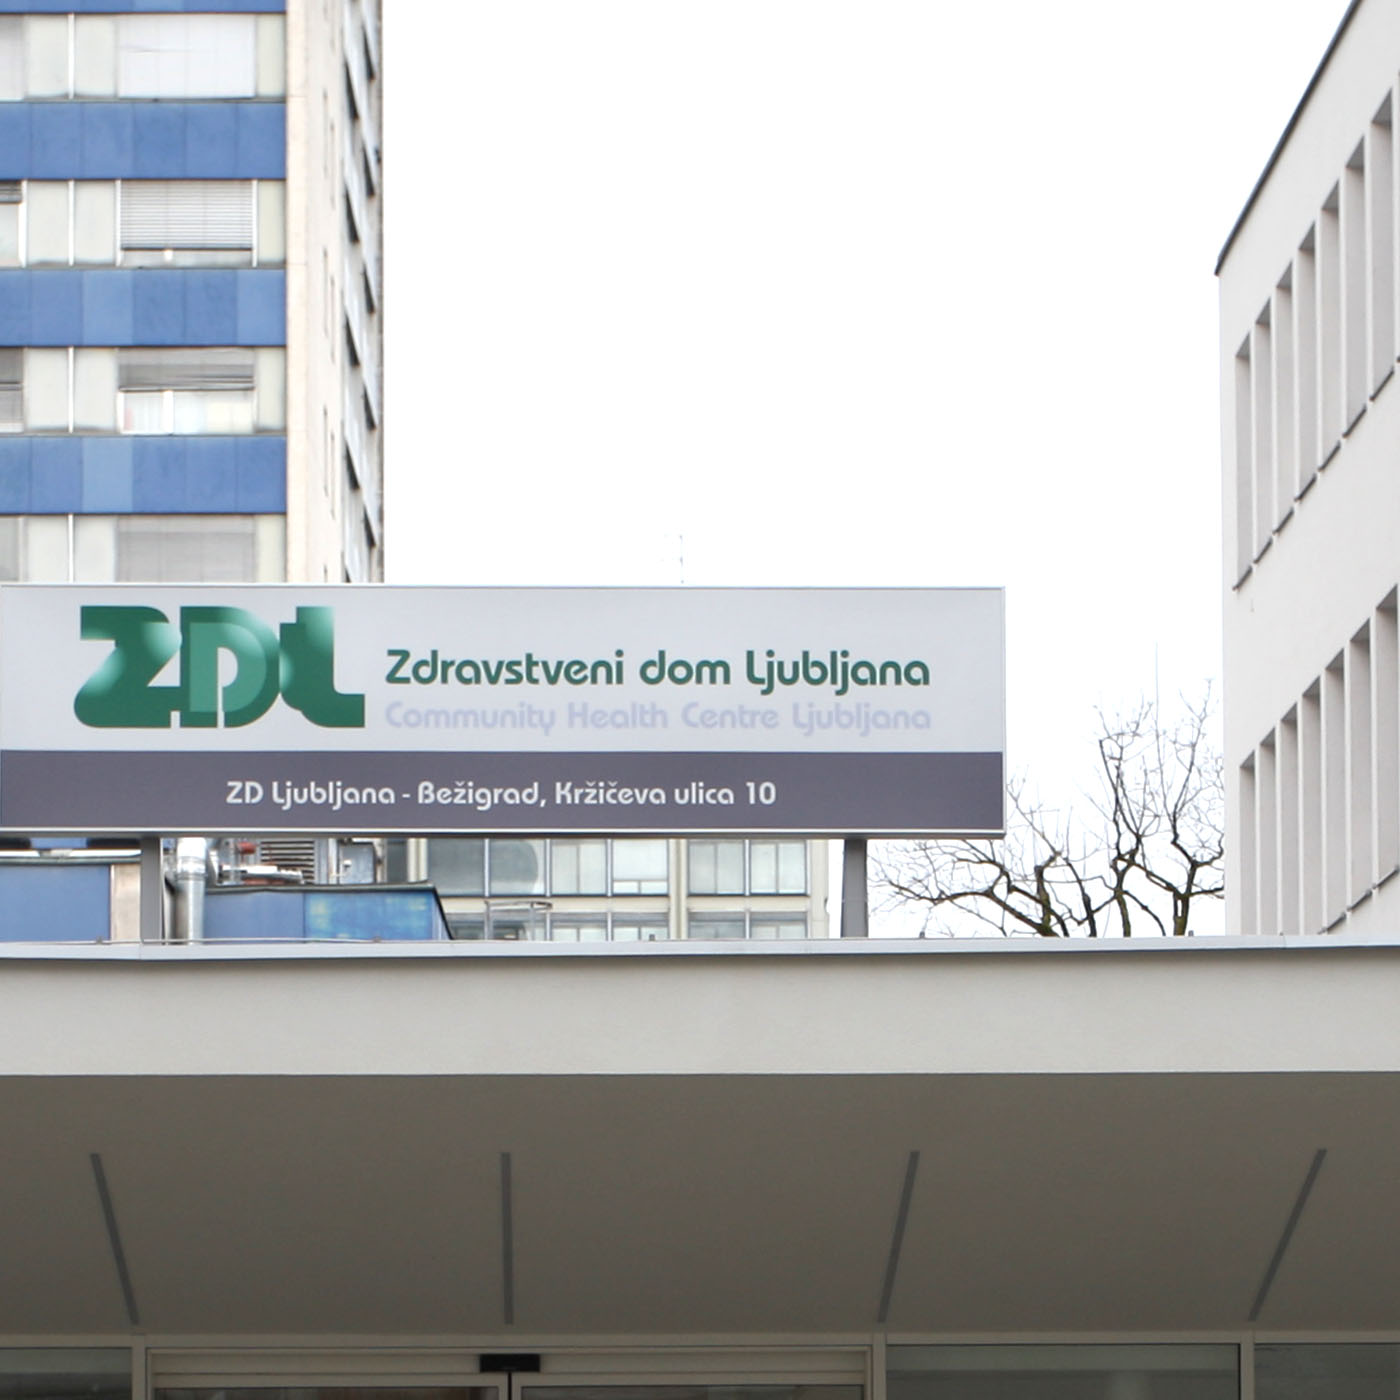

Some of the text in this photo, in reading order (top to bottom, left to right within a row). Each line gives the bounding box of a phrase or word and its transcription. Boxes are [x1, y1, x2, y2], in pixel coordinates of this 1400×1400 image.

[73, 606, 365, 729] ZDL
[385, 648, 931, 697] Zdravstveni dom Ljubljana
[384, 701, 932, 739] Community Health Centre Ljubljana
[225, 780, 265, 805] ZD
[271, 779, 397, 812] Ljubljana
[417, 779, 546, 812] Bežigrad,
[555, 779, 668, 806] Kržičeva
[674, 780, 736, 805] ulica
[746, 780, 777, 805] 10
